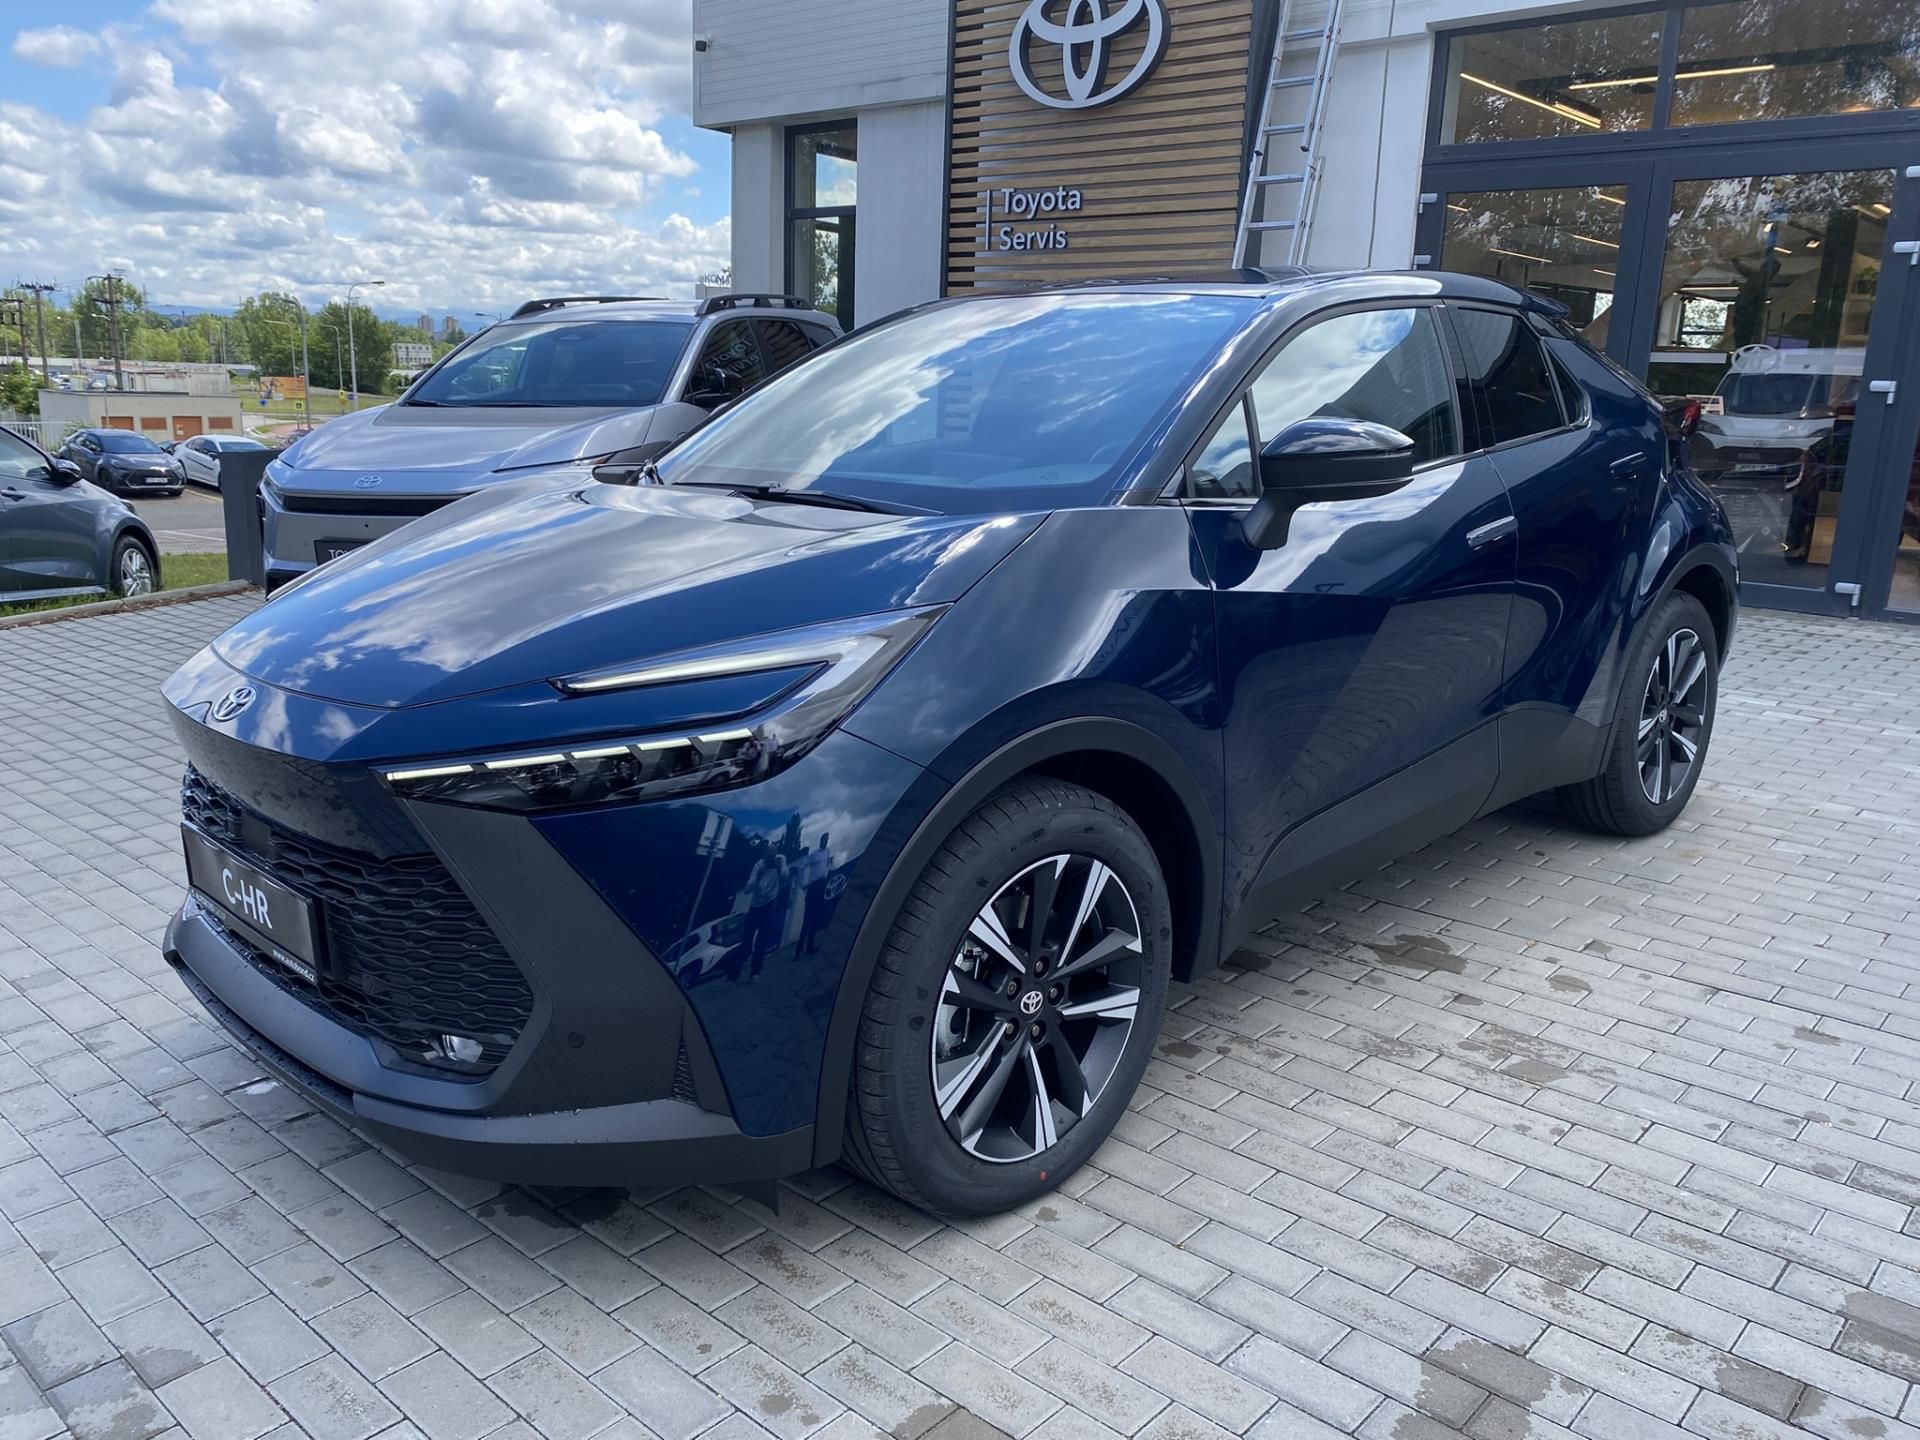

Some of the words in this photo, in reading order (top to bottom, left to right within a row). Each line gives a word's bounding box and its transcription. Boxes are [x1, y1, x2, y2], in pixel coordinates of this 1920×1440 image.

[1001, 186, 1082, 219] Toyota
[1000, 224, 1067, 250] Servis
[222, 868, 273, 929] C-HR
